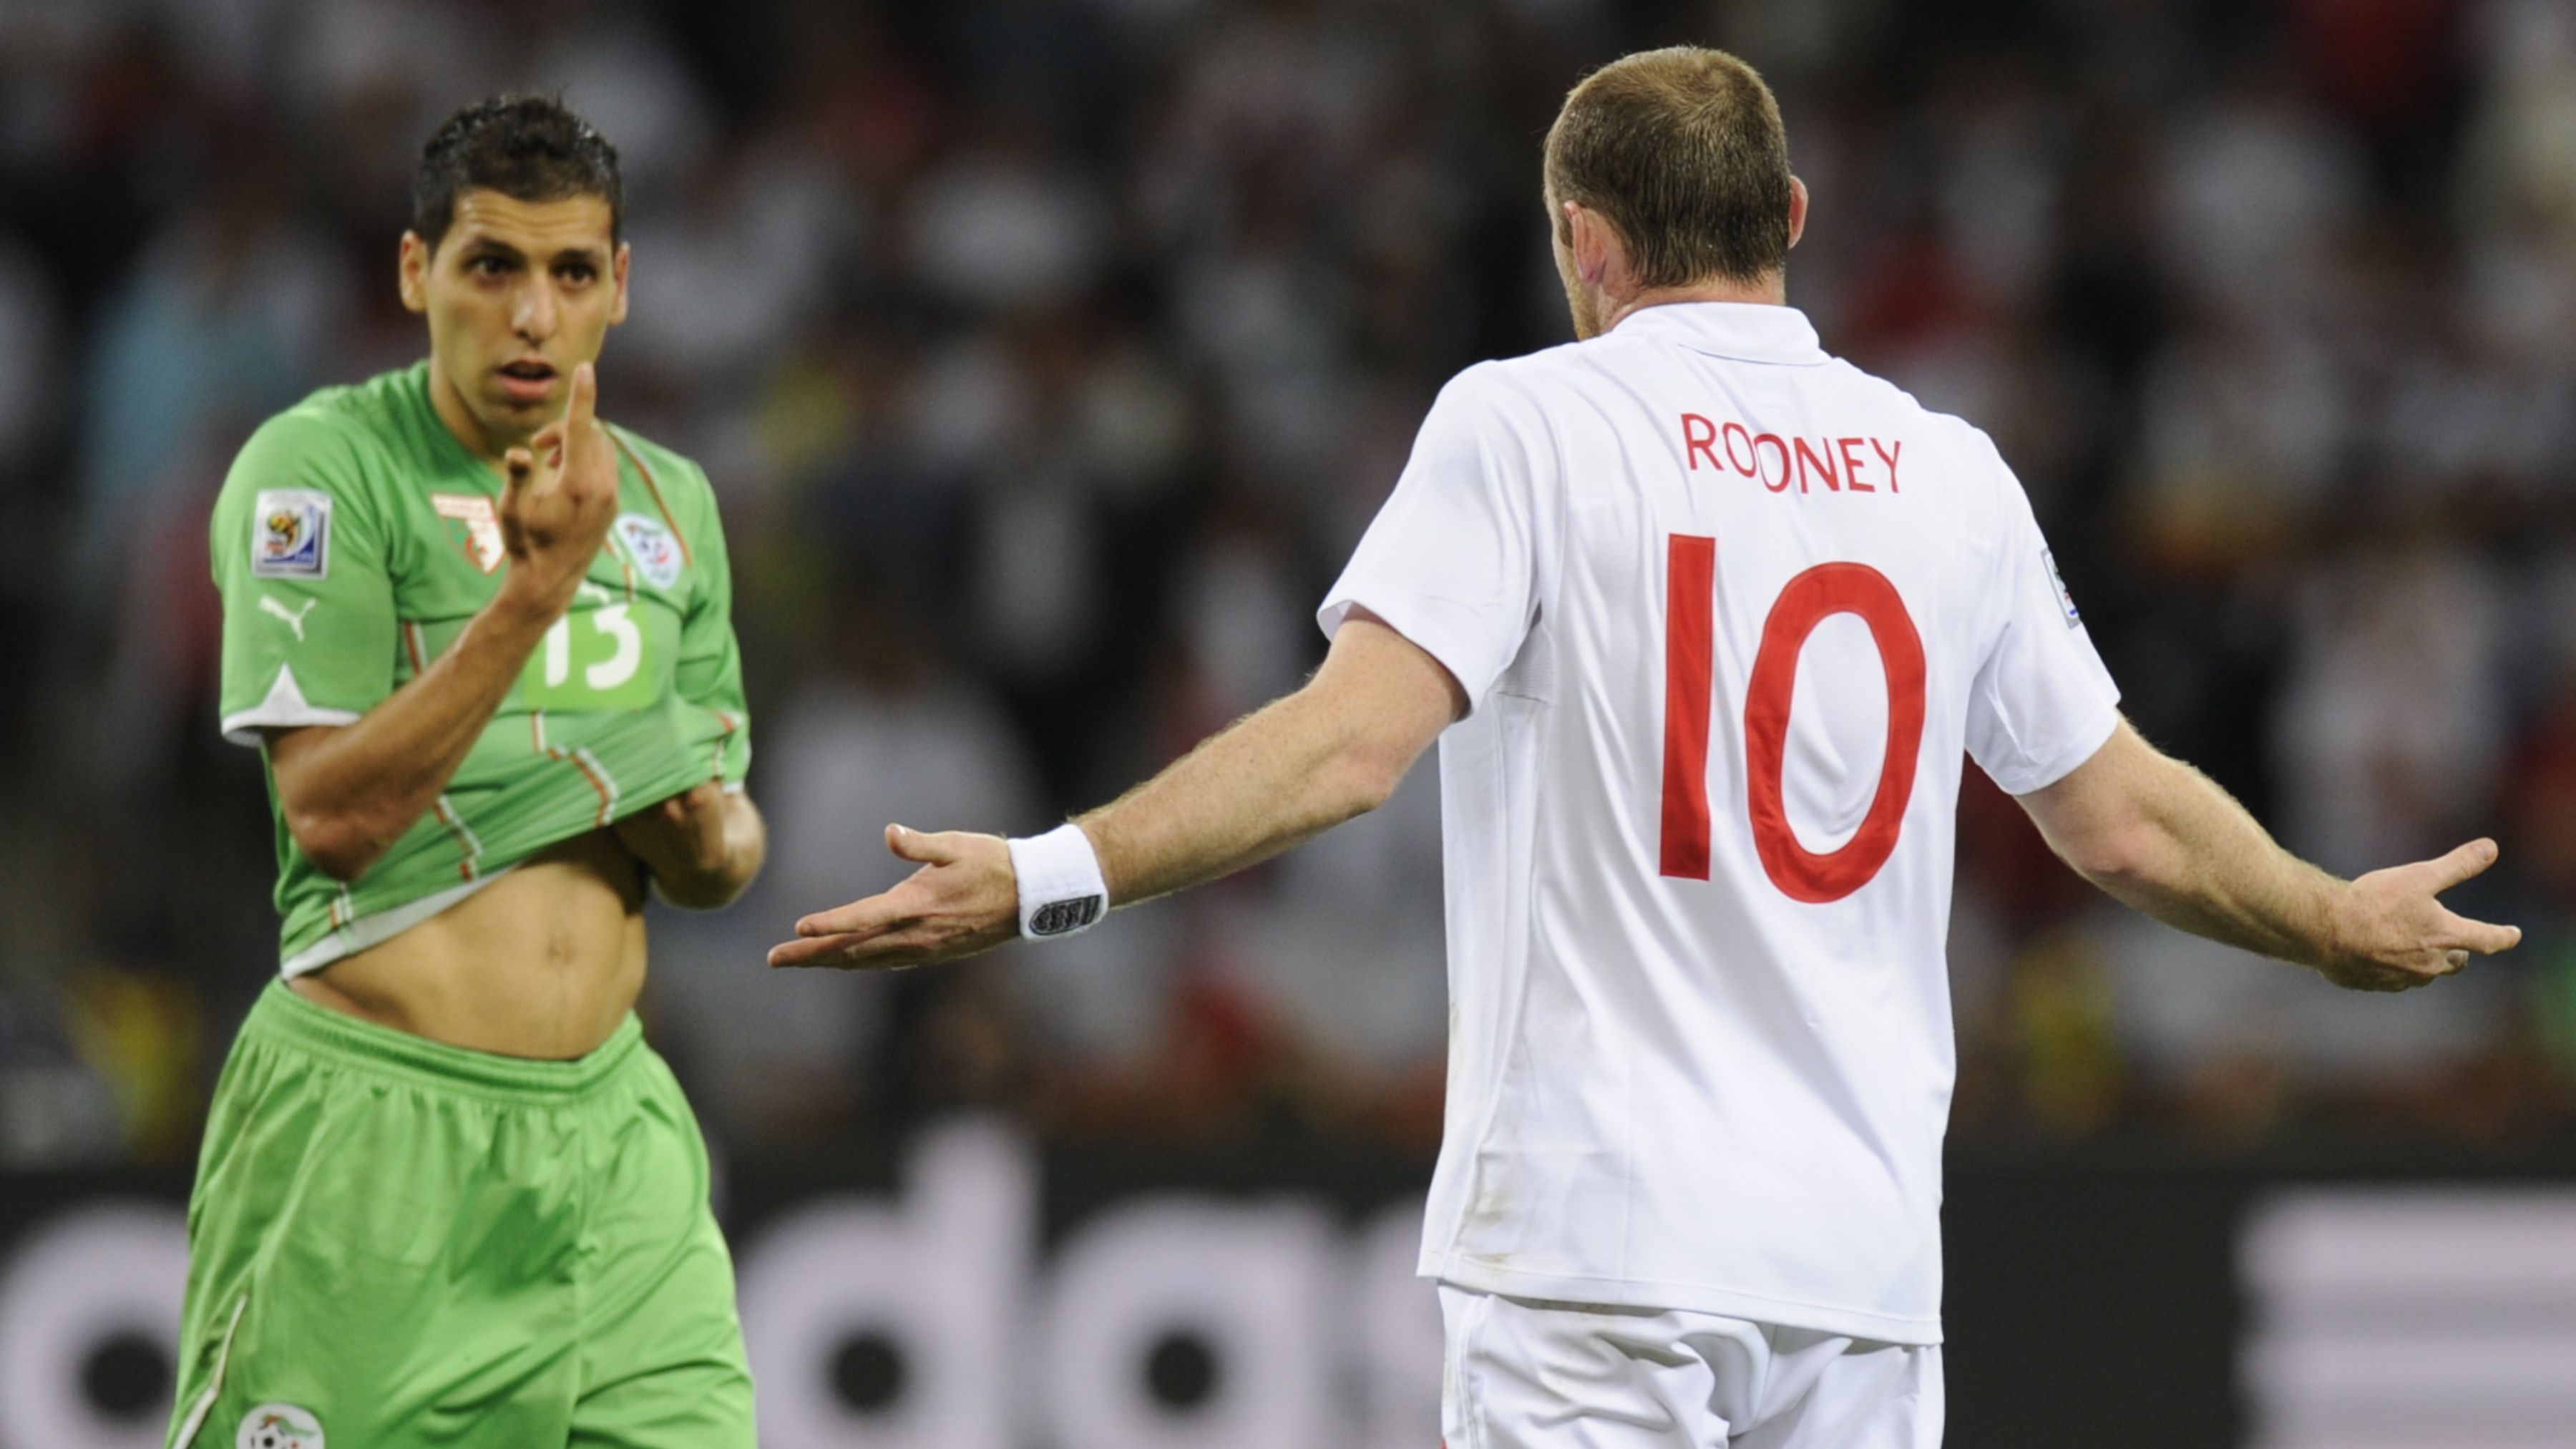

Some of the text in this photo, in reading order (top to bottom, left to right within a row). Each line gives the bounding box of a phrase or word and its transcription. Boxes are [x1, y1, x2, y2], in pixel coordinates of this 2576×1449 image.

[1680, 413, 1901, 494] ROONEY
[545, 602, 642, 690] 13
[1659, 532, 1926, 904] 10
